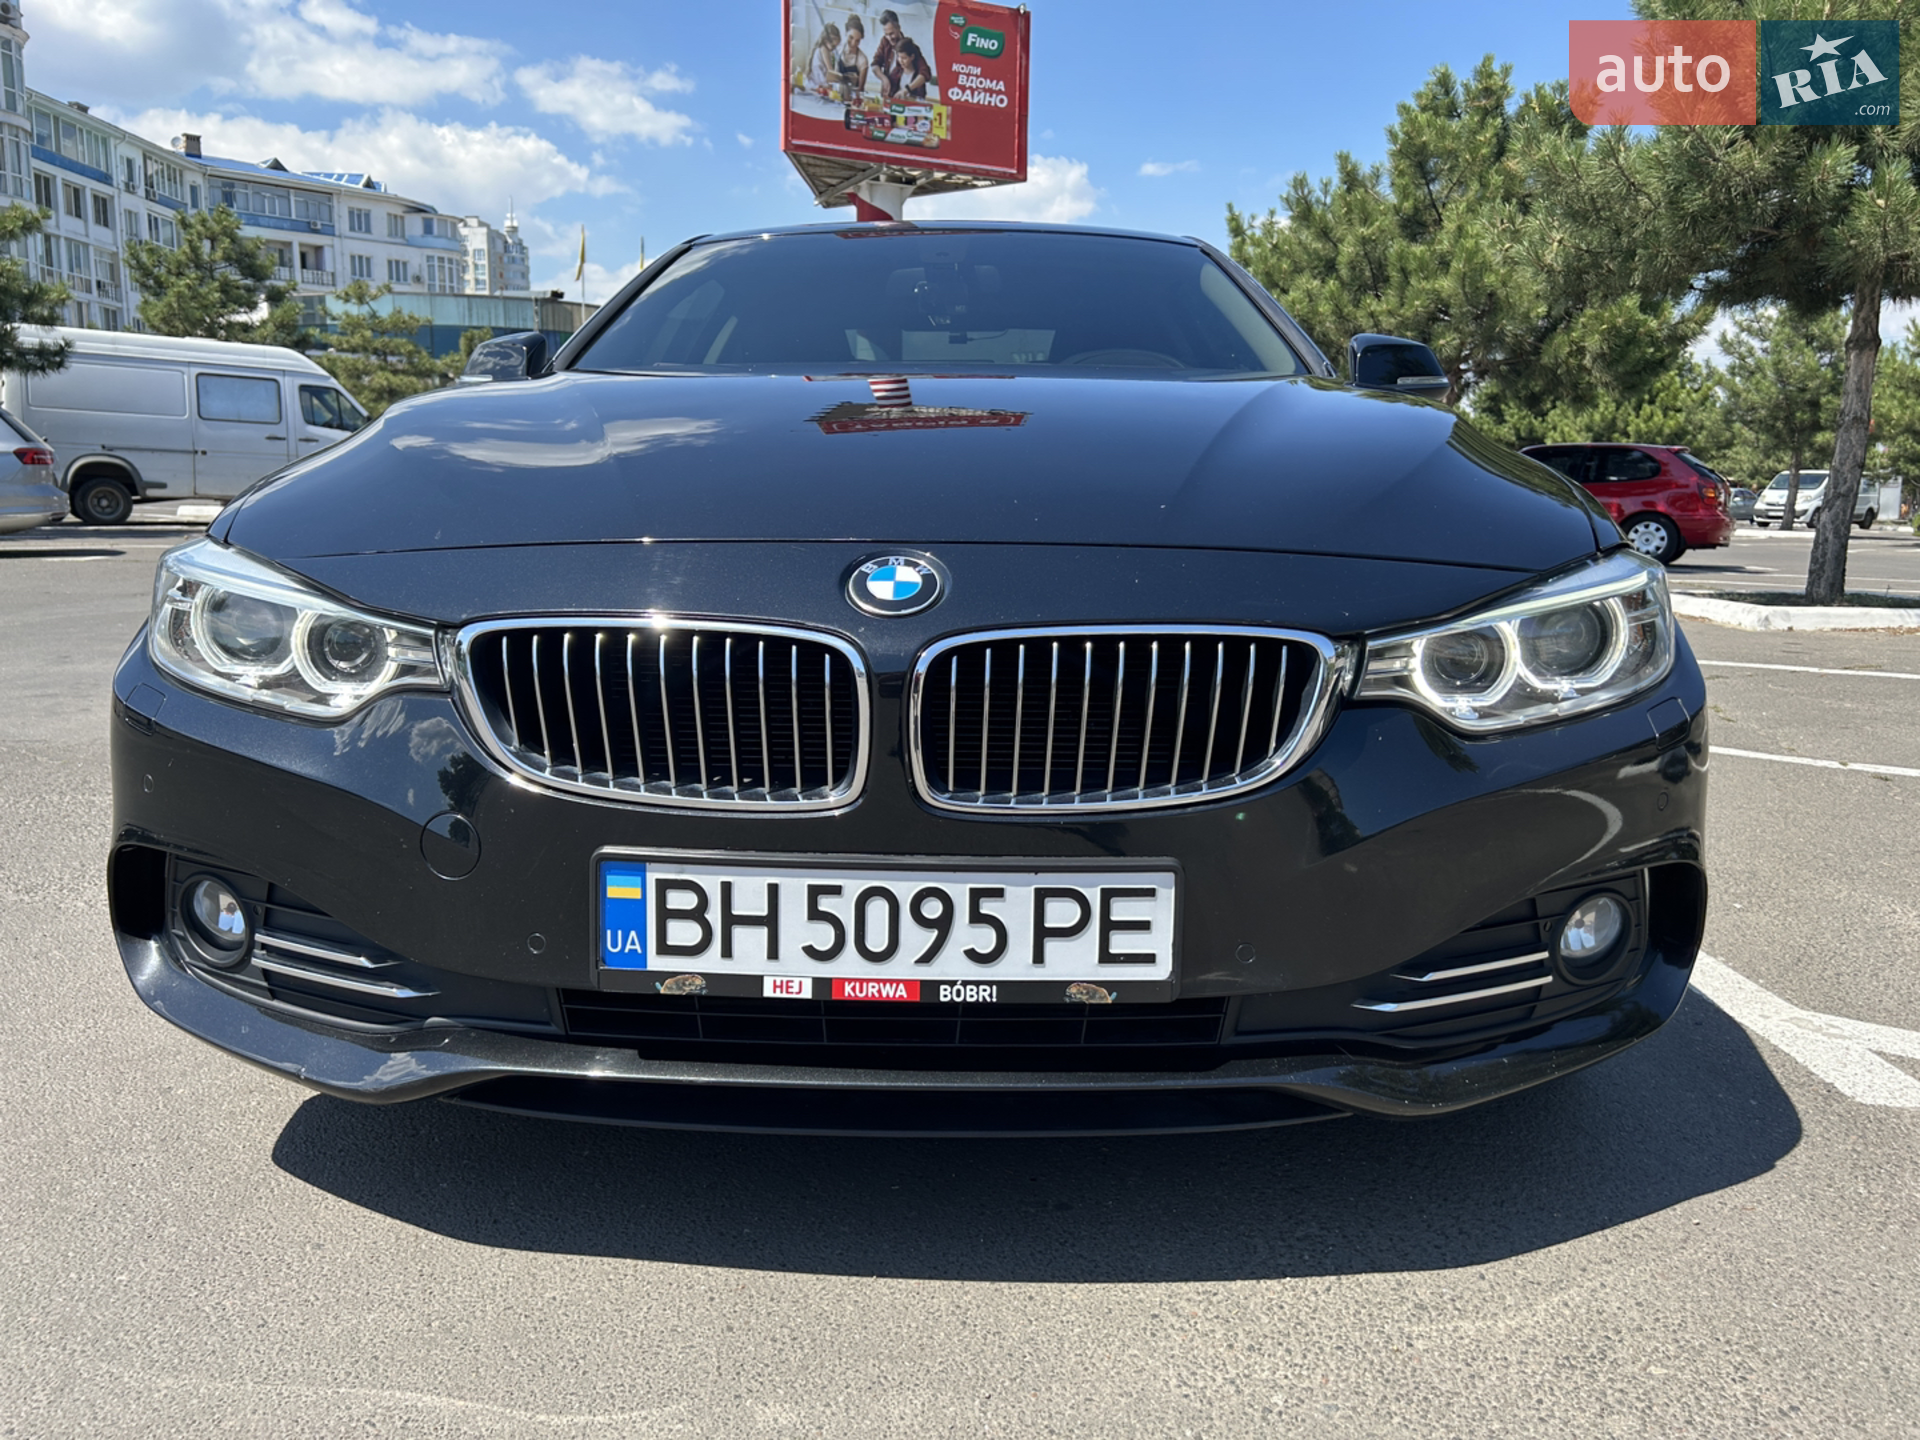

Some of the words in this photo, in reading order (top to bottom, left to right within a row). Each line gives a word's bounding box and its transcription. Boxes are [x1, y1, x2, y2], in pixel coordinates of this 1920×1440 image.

[967, 33, 998, 50] FINO
[952, 63, 981, 75] КОЛИ
[958, 74, 1005, 92] ВДОМА
[947, 86, 1008, 108] ФАЙНО
[860, 557, 932, 575] BMW
[655, 877, 779, 960] BH
[801, 883, 1008, 965] 5095
[1031, 886, 1157, 965] PE
[606, 930, 642, 953] UA
[773, 979, 803, 995] HEJ
[845, 981, 907, 998] KURWA
[939, 980, 997, 1003] BÓBR!
